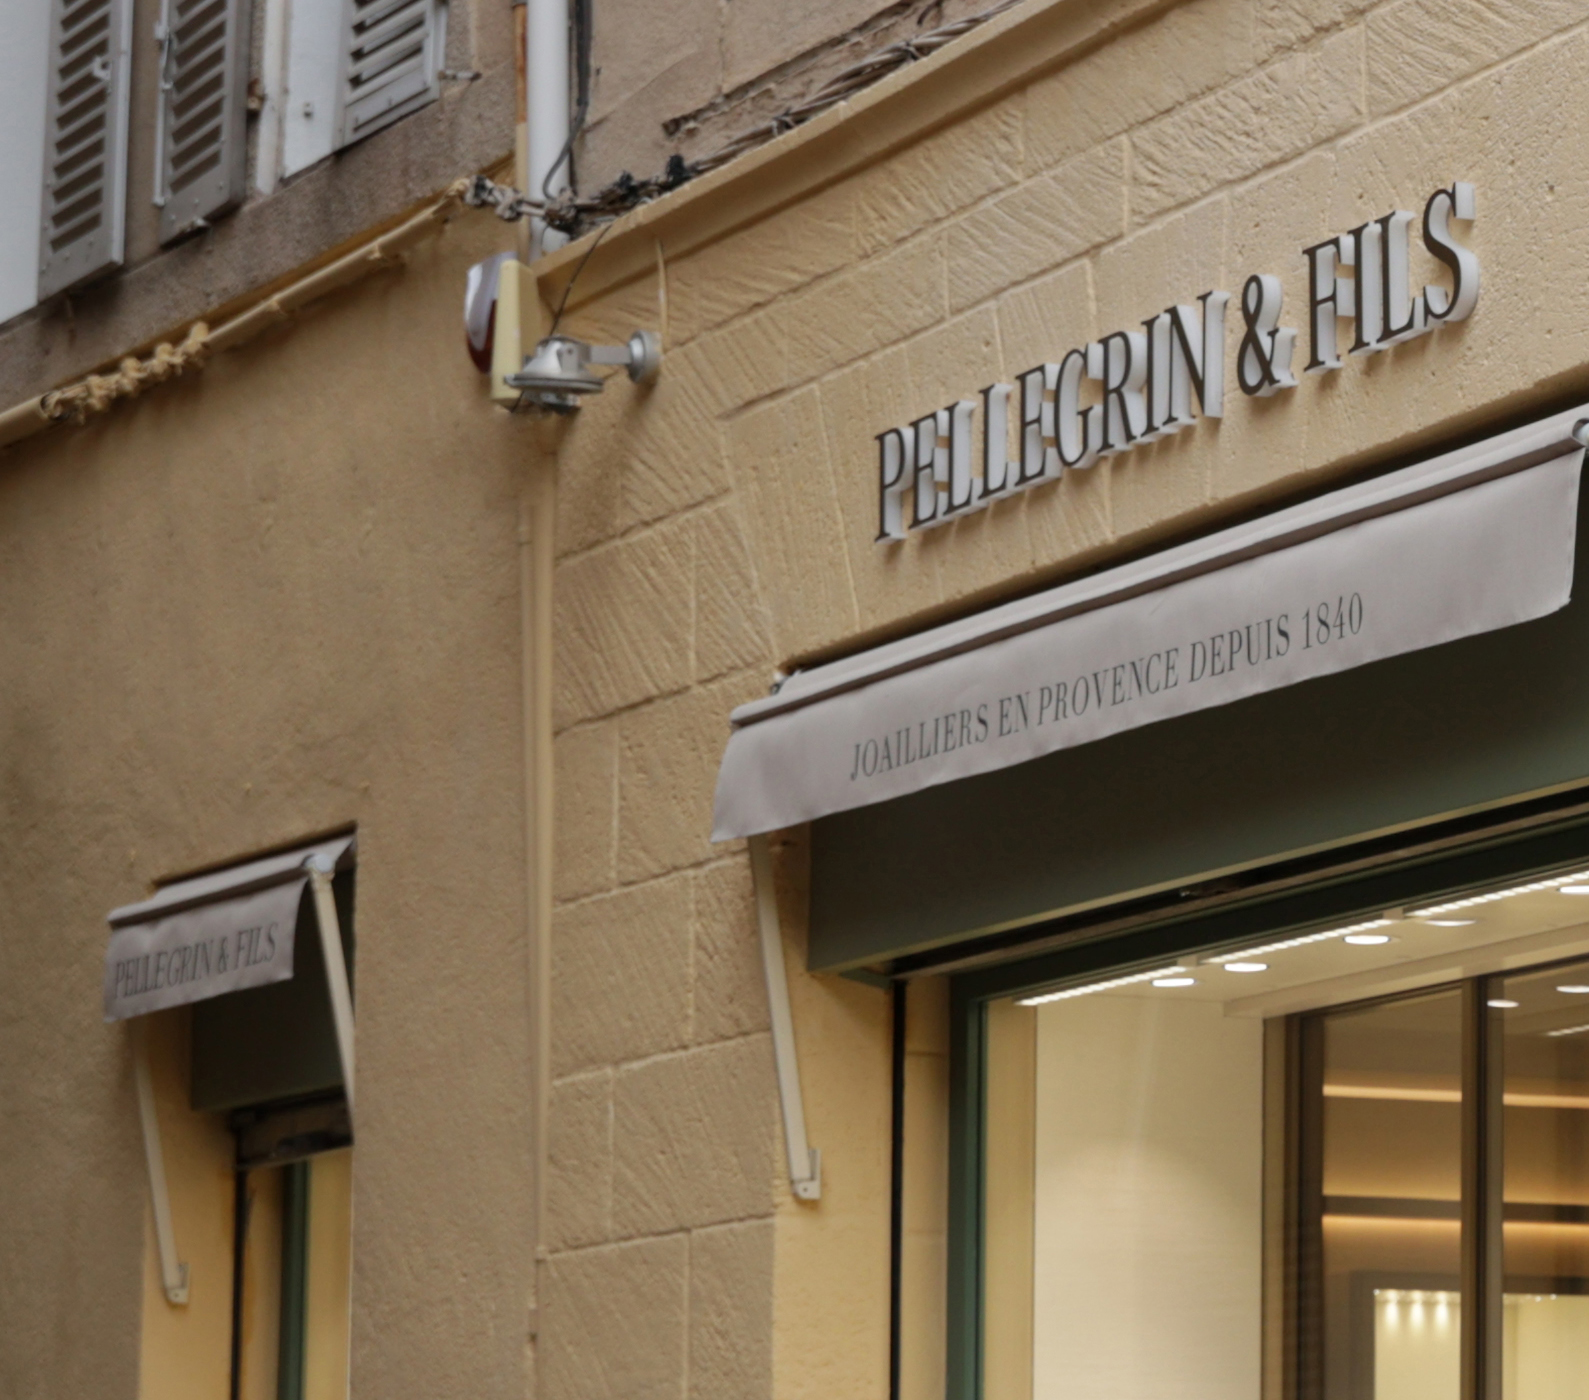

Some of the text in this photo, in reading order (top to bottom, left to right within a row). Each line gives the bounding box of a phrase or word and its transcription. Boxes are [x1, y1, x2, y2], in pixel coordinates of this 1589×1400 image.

[874, 182, 1480, 542] PELLEGRIN & FILS
[850, 591, 1364, 782] JOAILLIERS EN PROVENCE DEPUIS 1840
[113, 923, 278, 999] PELLEGRIN & FILS
